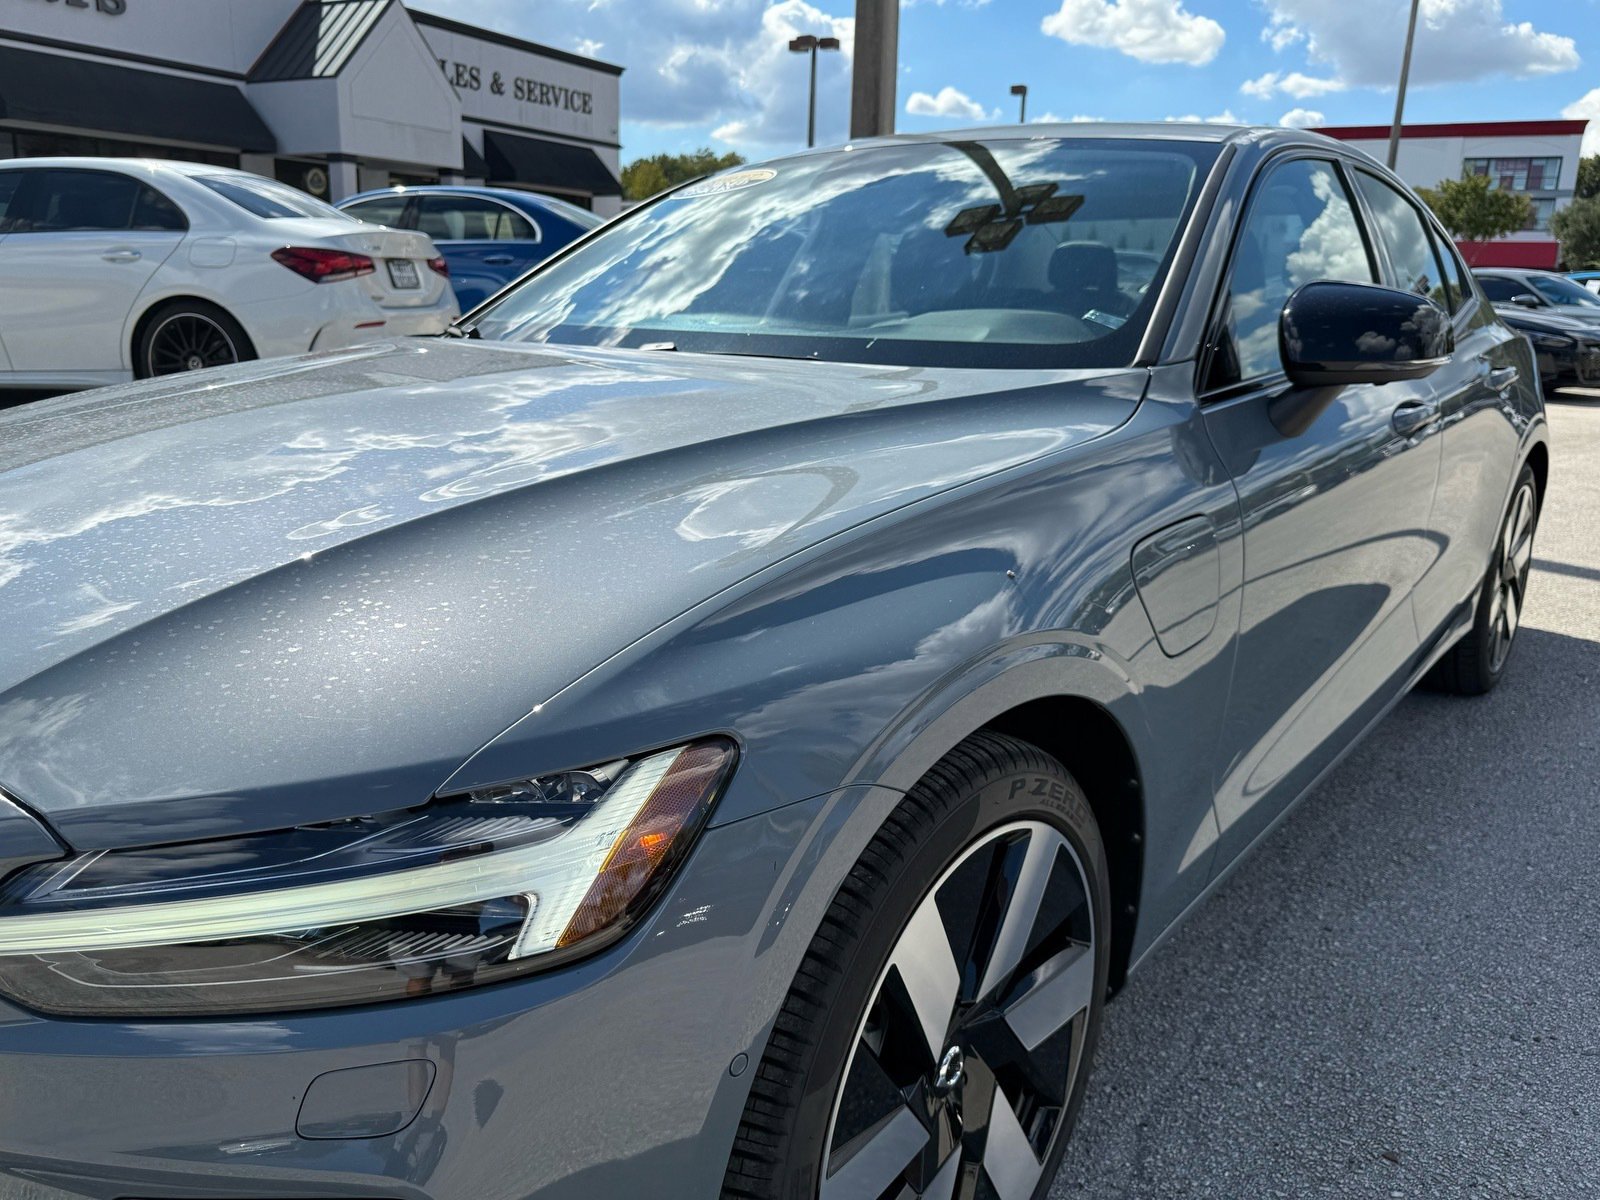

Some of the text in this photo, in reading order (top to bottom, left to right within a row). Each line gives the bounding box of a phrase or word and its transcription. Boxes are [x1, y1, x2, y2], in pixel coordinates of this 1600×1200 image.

[490, 71, 505, 96] &
[514, 76, 593, 115] SERVICE
[1008, 778, 1026, 800] P
